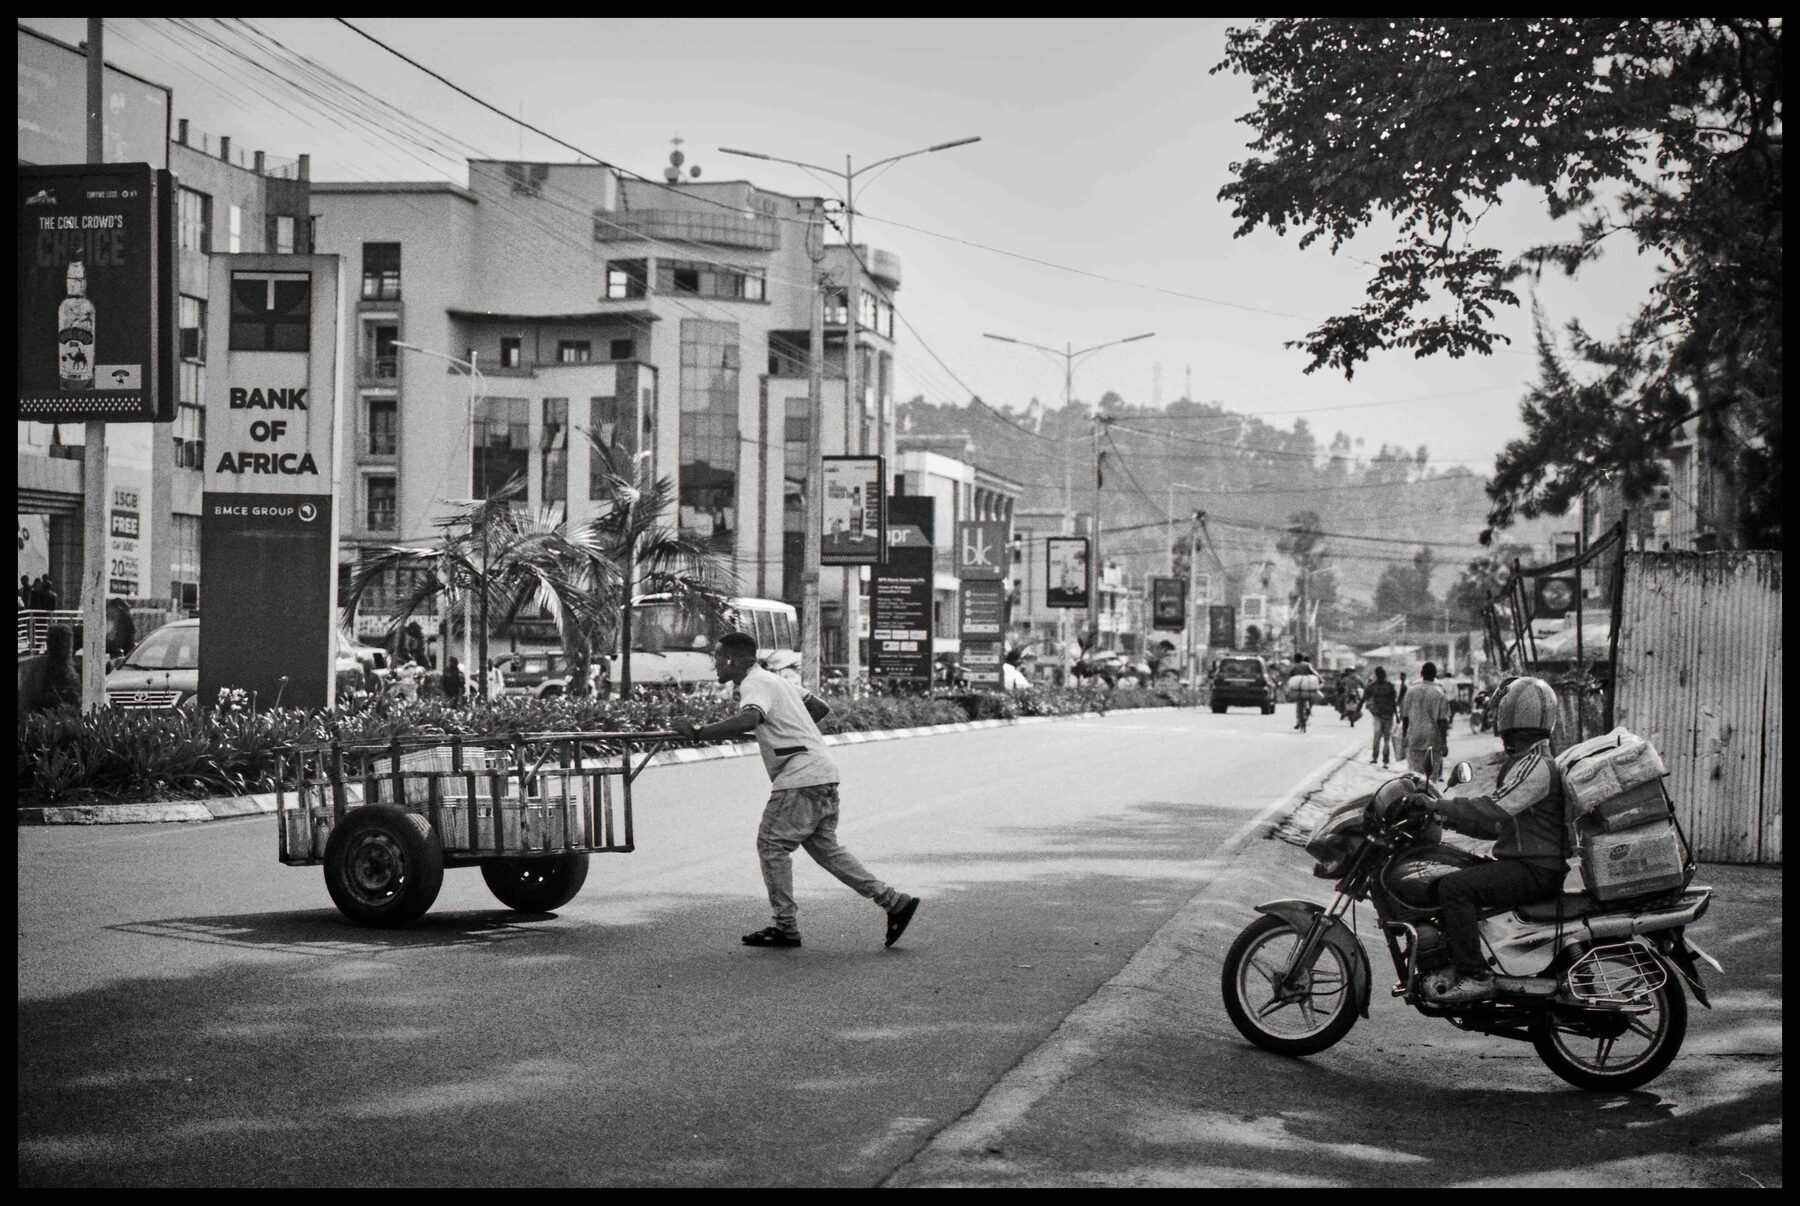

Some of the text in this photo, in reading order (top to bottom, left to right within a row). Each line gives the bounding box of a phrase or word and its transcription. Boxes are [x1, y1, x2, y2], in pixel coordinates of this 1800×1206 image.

[39, 214, 124, 230] THE COOL CROWD'S
[229, 387, 308, 411] BANK
[249, 420, 287, 442] OF
[215, 451, 319, 475] AFRICA
[214, 506, 294, 516] BMCE GROUP
[112, 515, 138, 535] FREE
[962, 527, 993, 566] bk
[110, 558, 125, 577] 20
